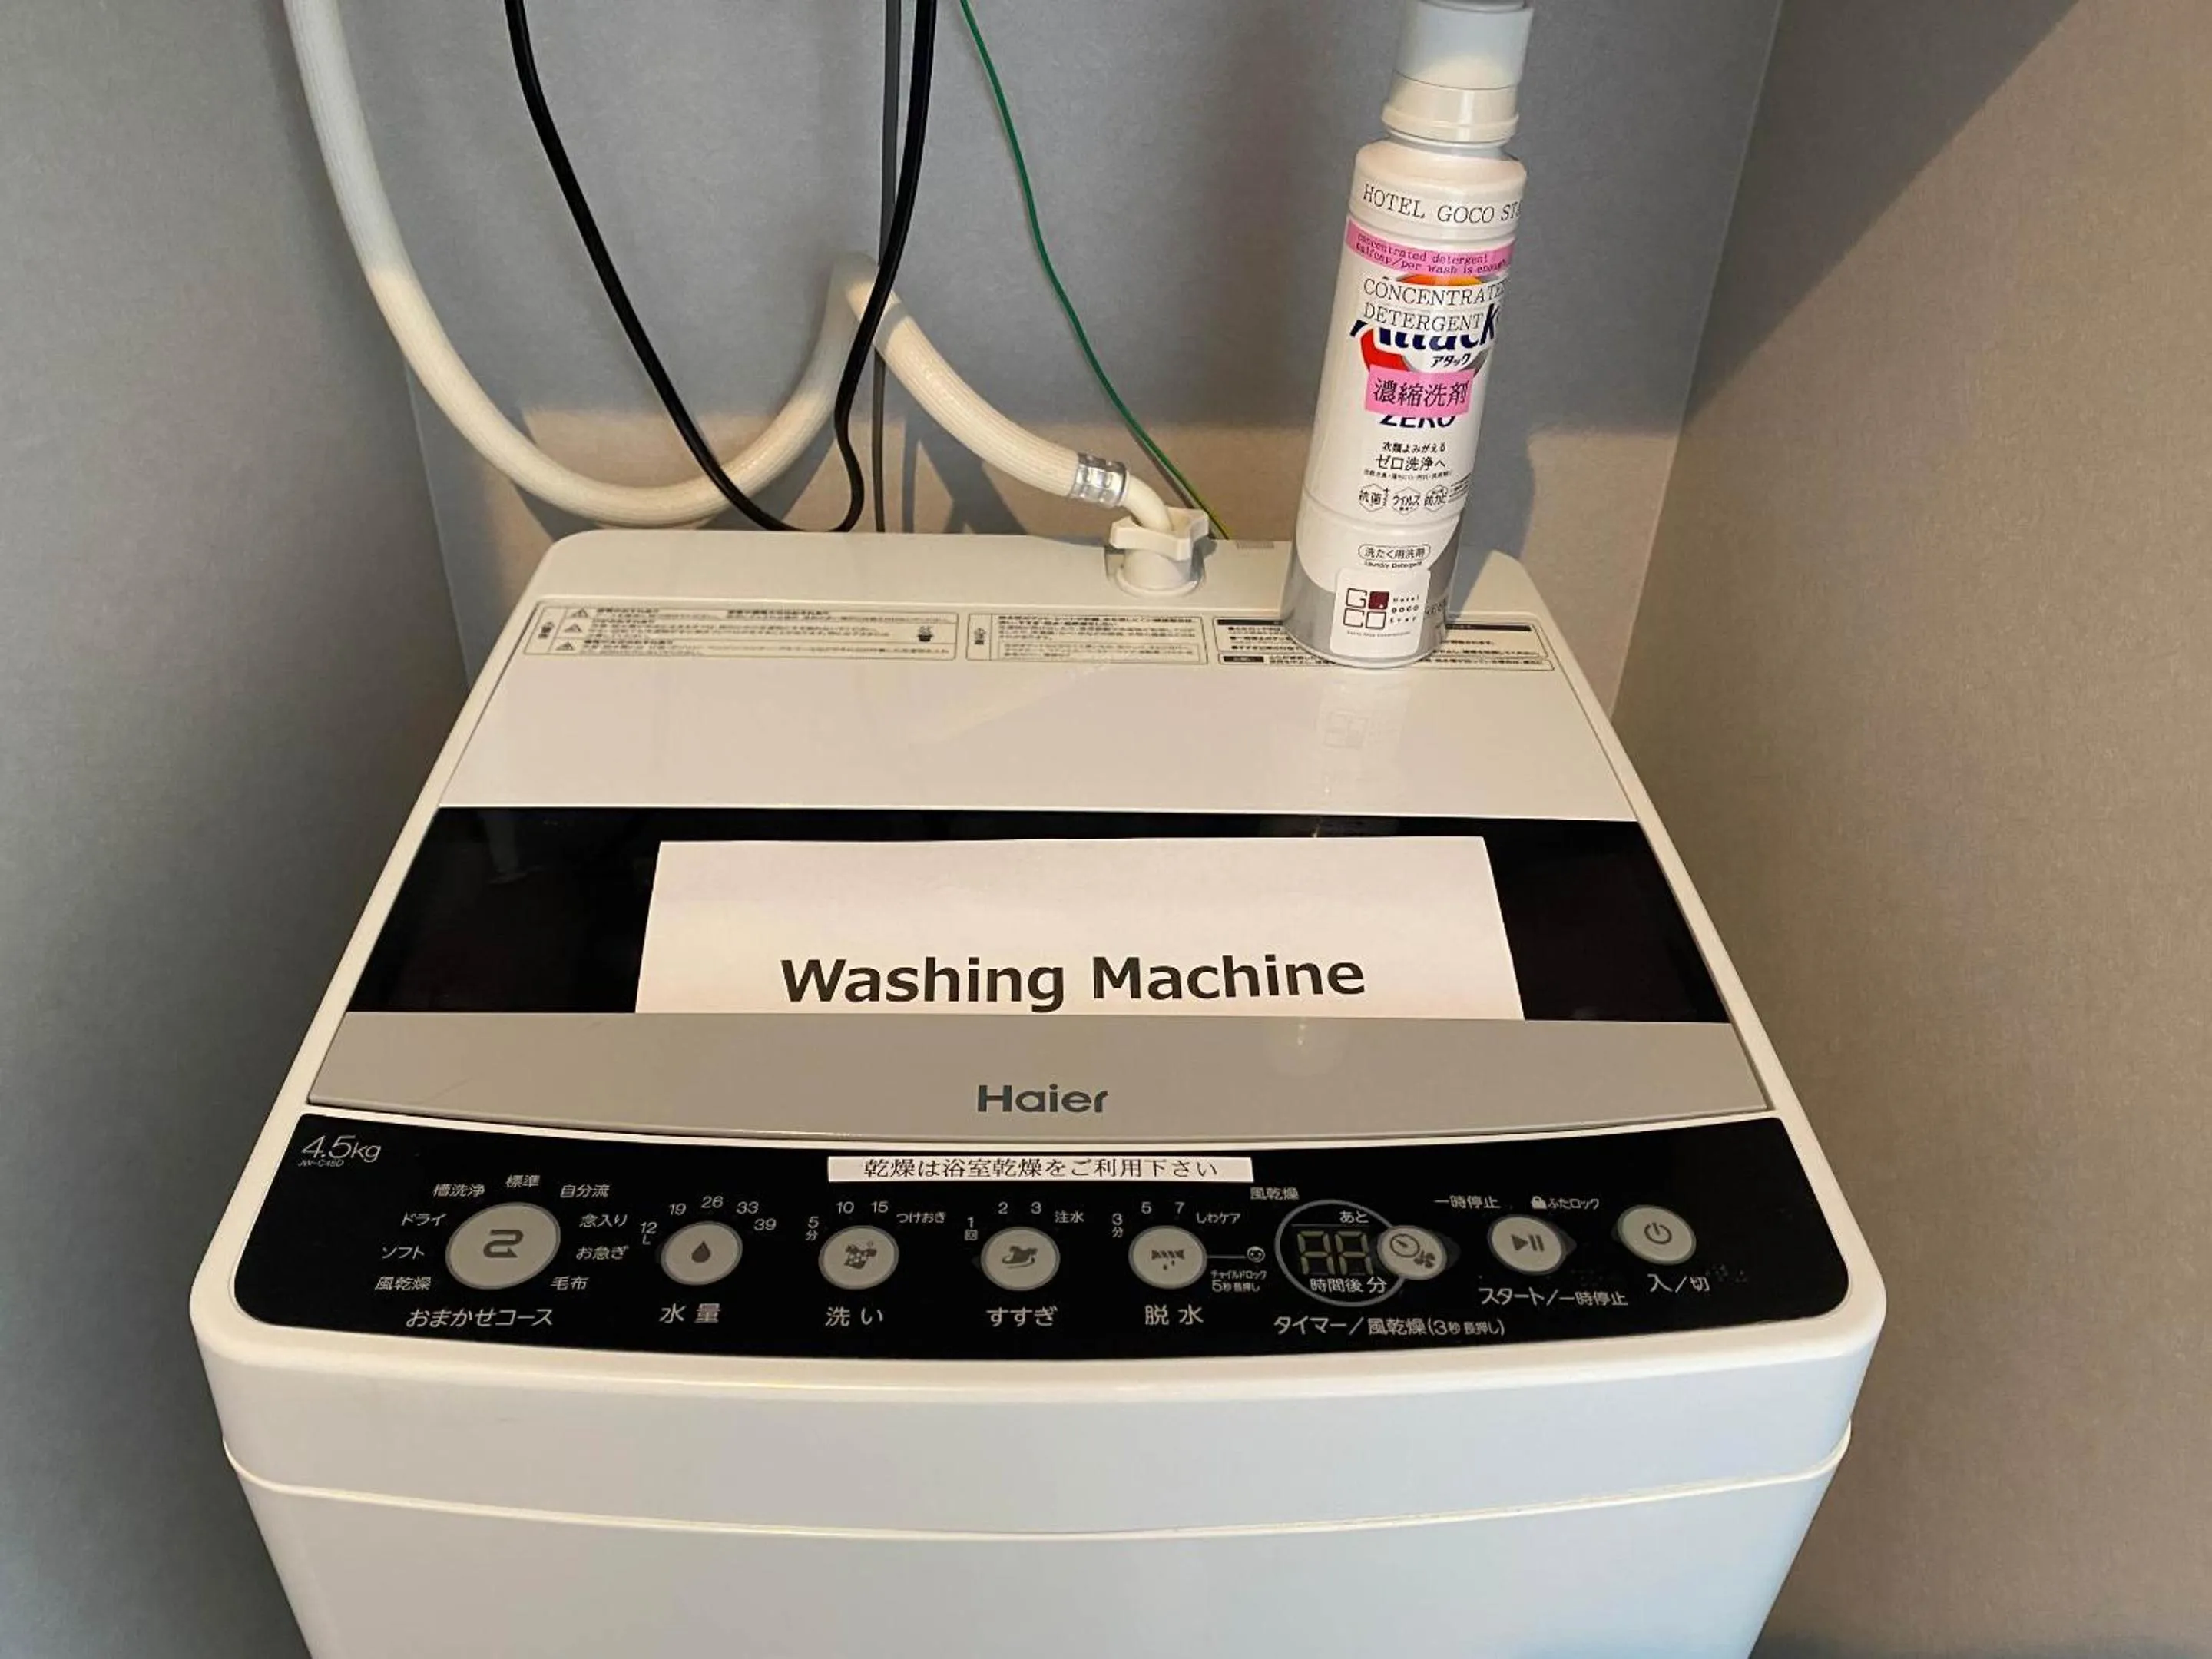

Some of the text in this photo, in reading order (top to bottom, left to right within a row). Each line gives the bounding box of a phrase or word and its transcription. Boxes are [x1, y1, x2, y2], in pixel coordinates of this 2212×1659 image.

[1363, 183, 1426, 218] HOTEL
[1437, 204, 1495, 224] GOCO
[1462, 264, 1473, 274] is
[1363, 302, 1484, 332] DETERGENT
[1430, 353, 1471, 368] アタック
[1373, 377, 1469, 407] 濃縮洗剤
[1376, 455, 1446, 471] ゼロ洗浄へ
[781, 954, 1365, 1012] Washing Machine
[977, 1083, 1109, 1113] Haier
[301, 1135, 382, 1164] 4.5kg
[864, 1158, 1218, 1178] 乾燥は浴室乾燥をご利用下さい
[505, 1174, 540, 1188] 標準
[433, 1184, 485, 1197] 槽洗浄
[560, 1184, 610, 1198] 自分流
[1250, 1187, 1299, 1200] 風乾燥
[701, 1195, 724, 1208] 26
[737, 1201, 759, 1214] 33
[837, 1201, 855, 1214] 10
[872, 1201, 889, 1214] 15
[998, 1201, 1008, 1214] 2
[1031, 1201, 1042, 1214] 3
[1141, 1201, 1152, 1214] 5
[1176, 1201, 1185, 1214] 7
[1435, 1195, 1501, 1209] 一時停止
[1547, 1197, 1601, 1210] ふたロック
[670, 1203, 687, 1215] 19
[402, 1213, 446, 1227] ドライ
[579, 1214, 628, 1228] 念入り
[753, 1218, 777, 1230] 39
[807, 1216, 819, 1229] 5
[896, 1211, 945, 1224] つけおき
[967, 1216, 974, 1228] 1
[1055, 1210, 1084, 1224] 注水
[1112, 1213, 1123, 1226] 3
[1196, 1212, 1241, 1224] しわケア
[1339, 1210, 1370, 1224] あと
[641, 1221, 657, 1234] 12
[1112, 1227, 1124, 1238] 分
[806, 1229, 818, 1241] 分
[964, 1229, 978, 1241] 回
[382, 1246, 425, 1260] ソフト
[575, 1245, 628, 1260] お急ぎ
[374, 1276, 432, 1291] 風乾燥
[551, 1276, 589, 1291] 毛布
[1310, 1276, 1387, 1293] 時間後 分
[1647, 1273, 1710, 1293] 入/切
[406, 1308, 552, 1328] おまかせコース
[659, 1303, 720, 1323] 水量
[825, 1306, 883, 1326] 洗い
[986, 1306, 1058, 1327] すすぎ
[1145, 1304, 1204, 1326] 脱水
